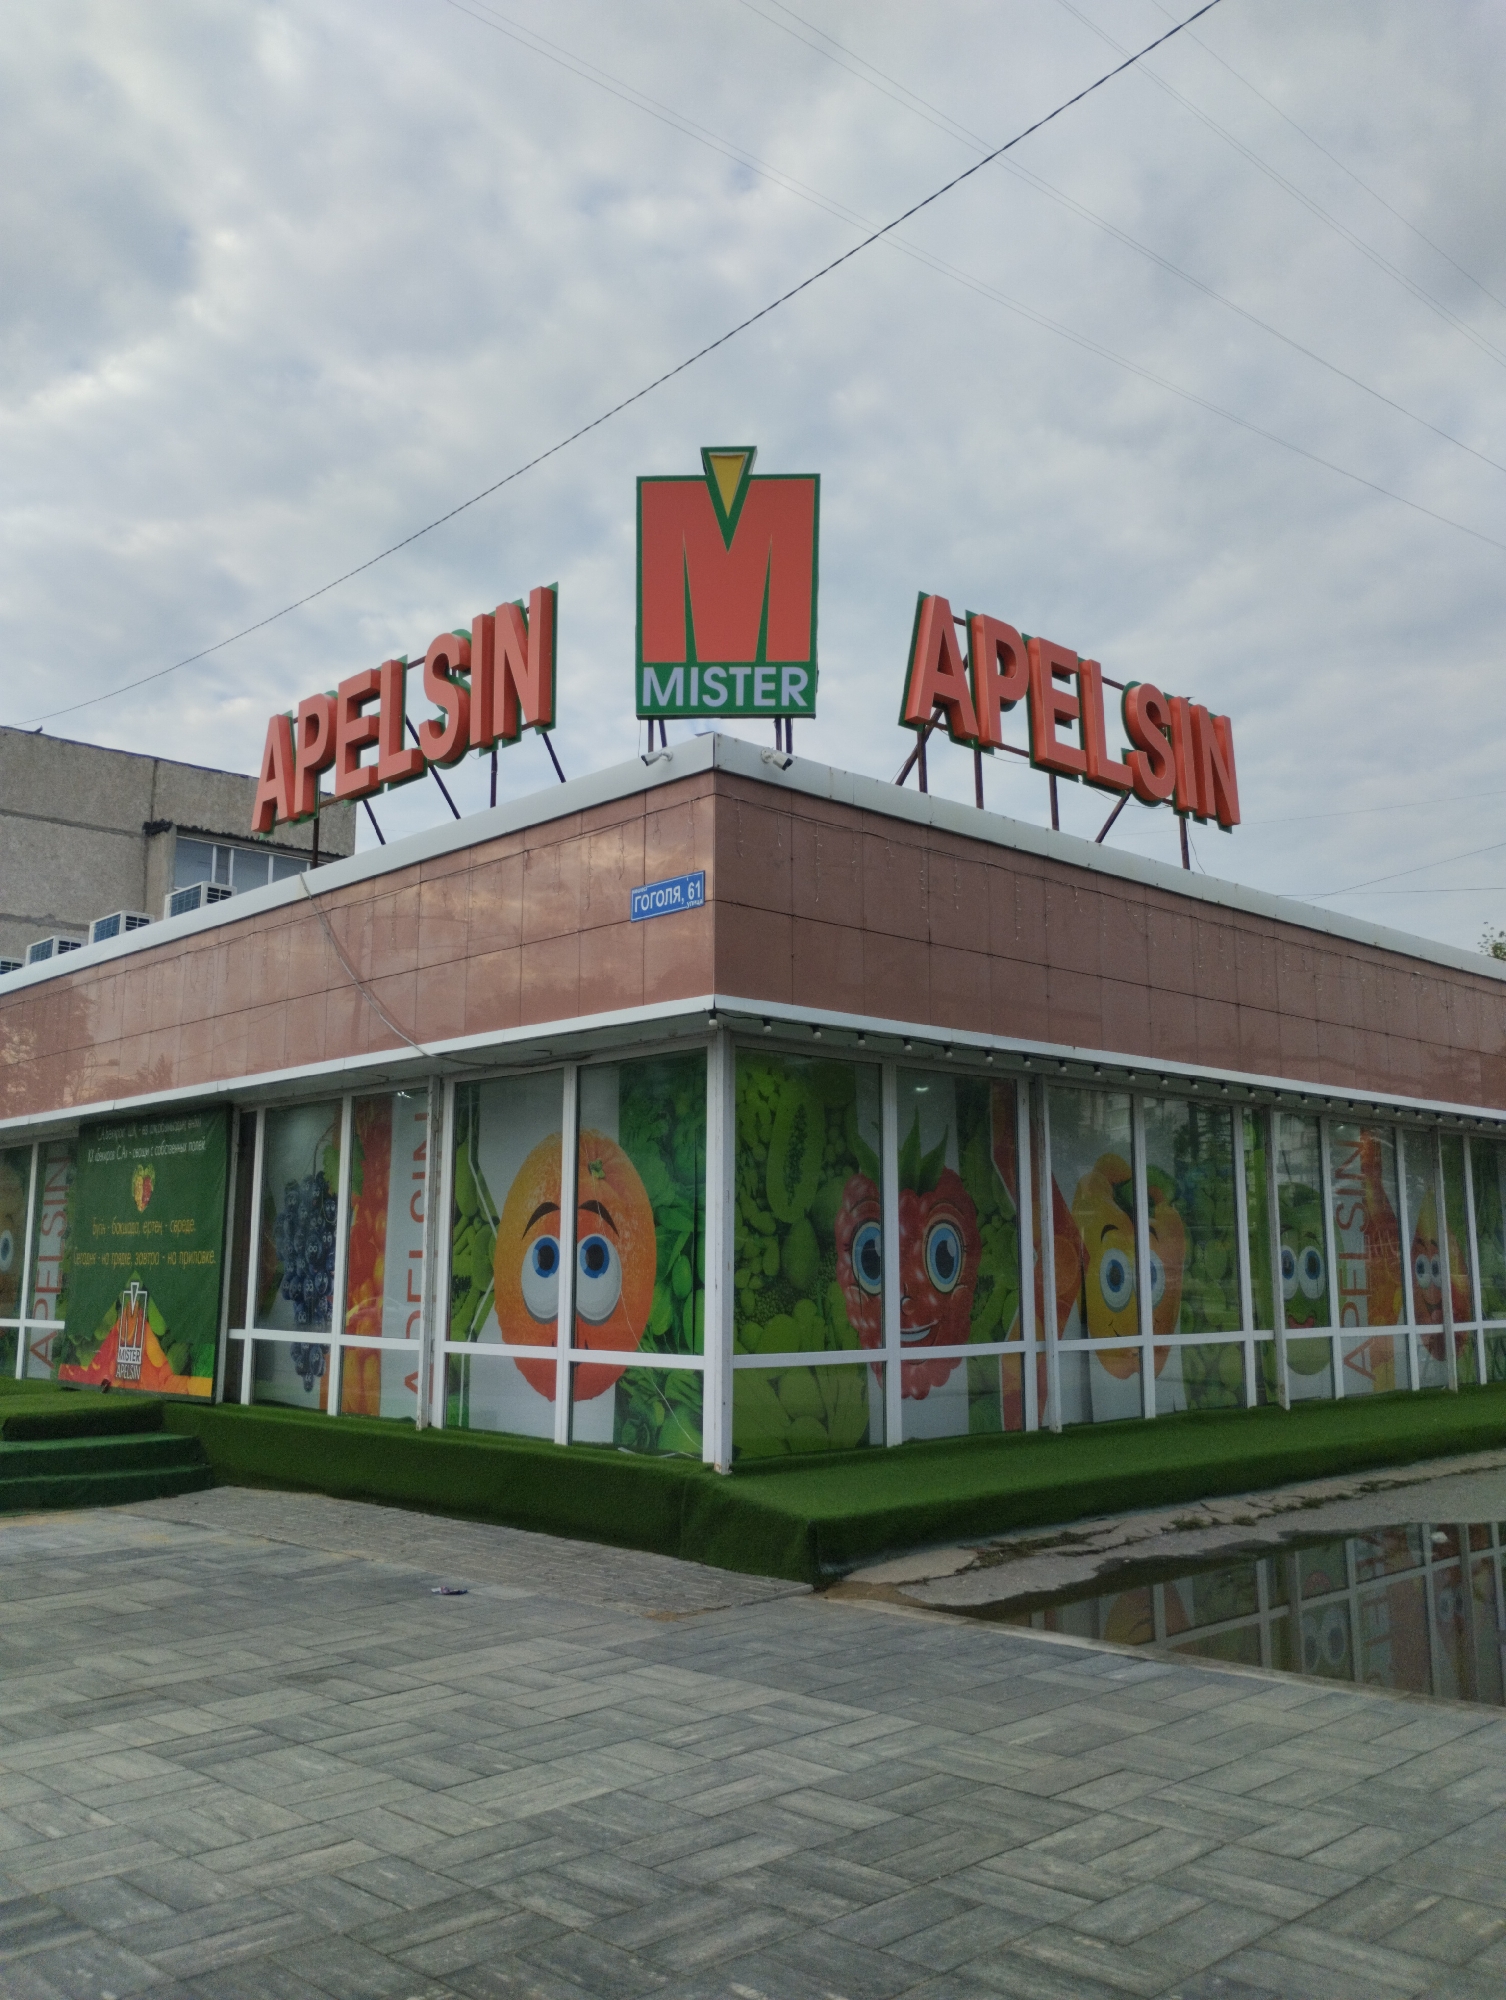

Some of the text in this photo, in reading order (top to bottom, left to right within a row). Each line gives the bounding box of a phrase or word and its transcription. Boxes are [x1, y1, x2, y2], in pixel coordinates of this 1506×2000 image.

[642, 666, 808, 707] MISTER
[251, 582, 558, 838] APELSIN
[899, 591, 1240, 833] APELSIN
[634, 880, 701, 913] ГОГОЛЯ, 61
[115, 1363, 141, 1380] APELSIN
[118, 1349, 141, 1362] MISTER
